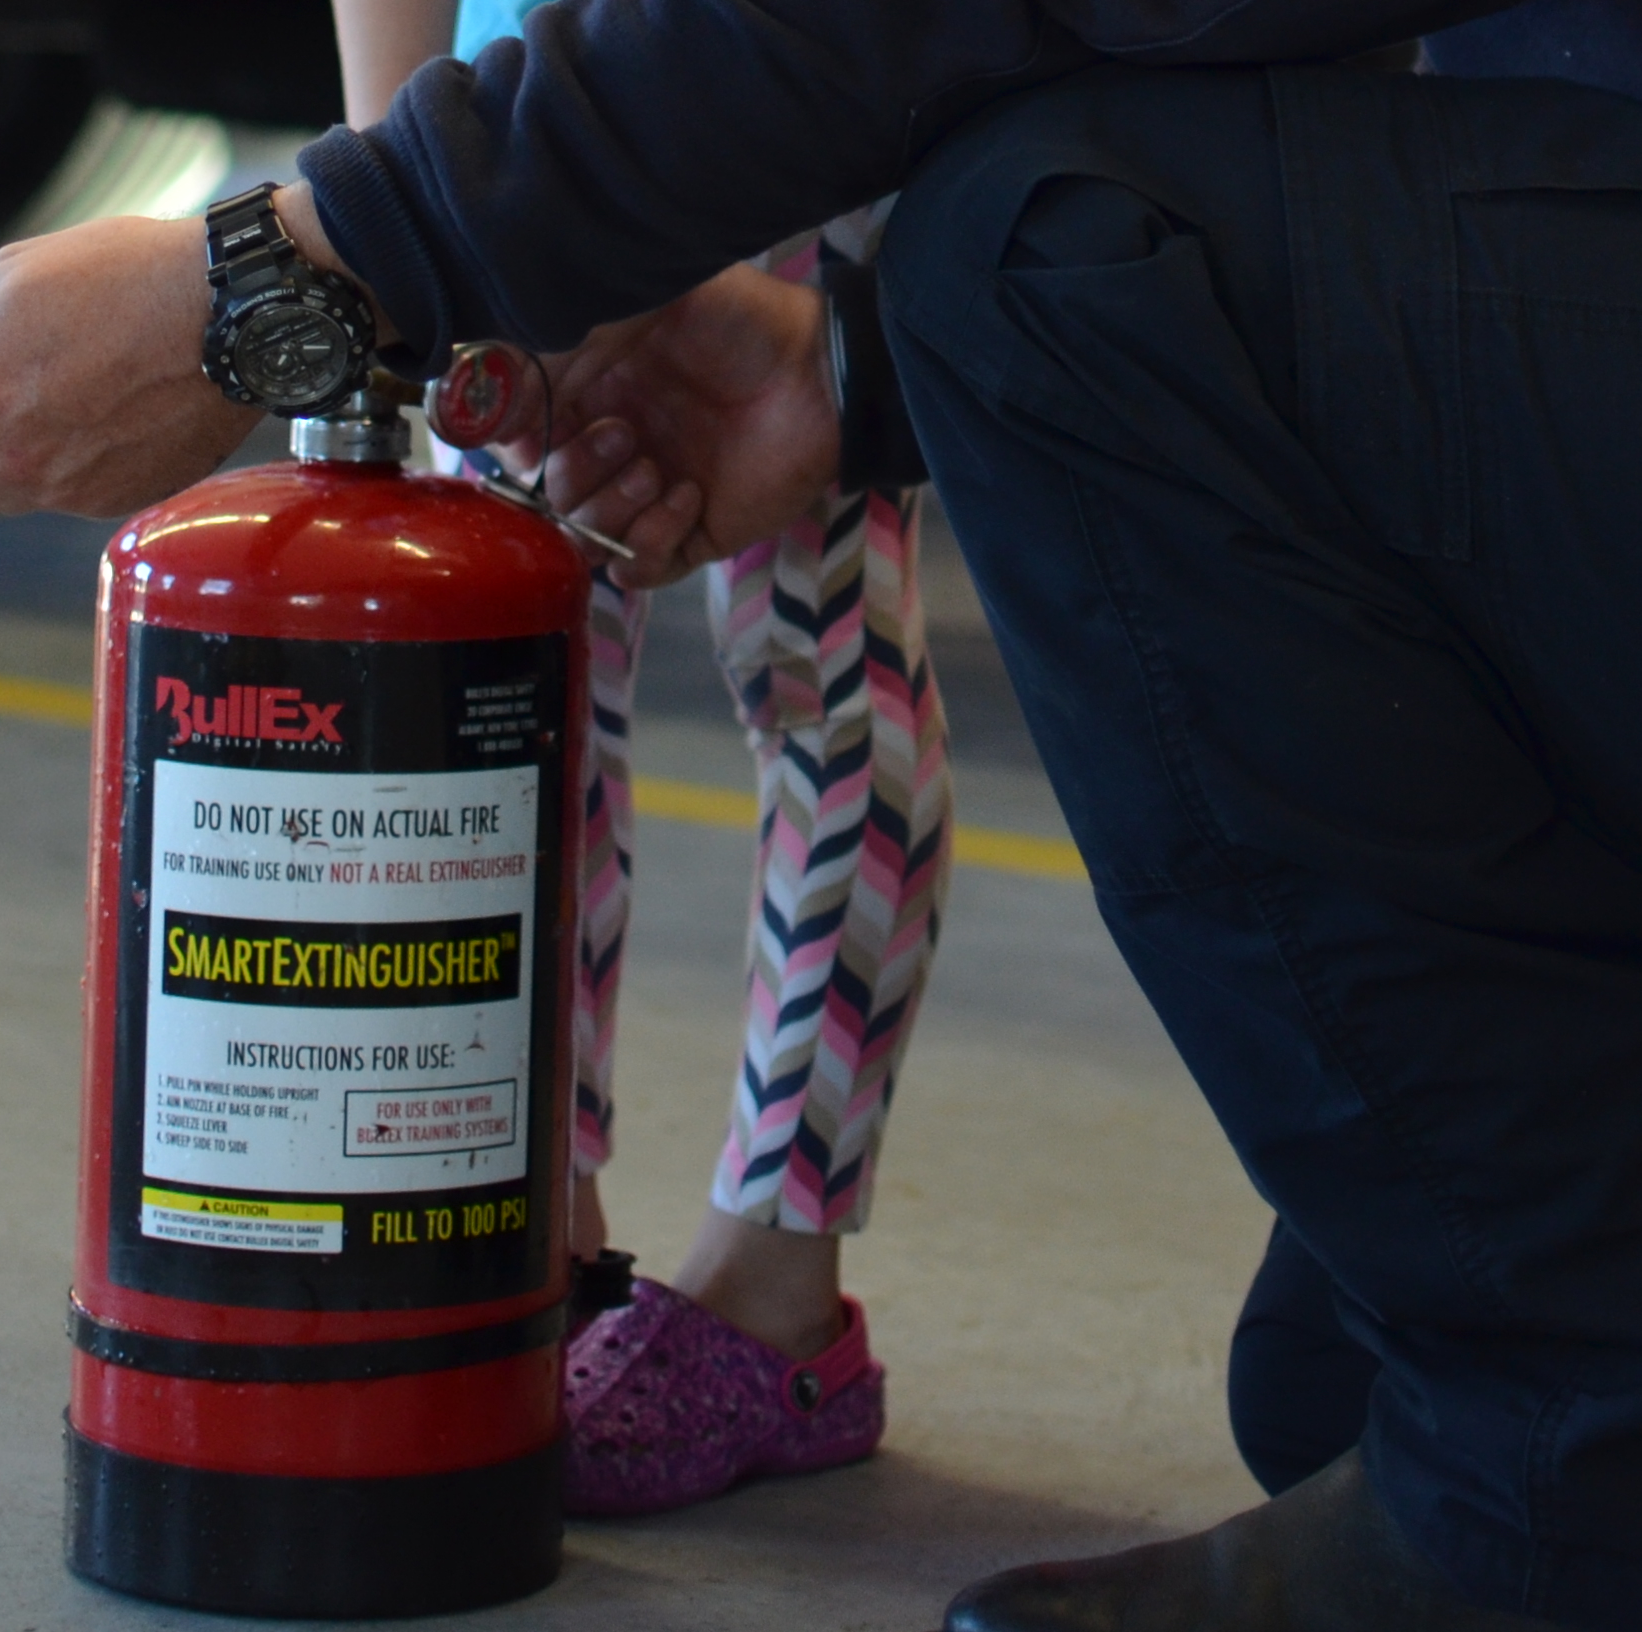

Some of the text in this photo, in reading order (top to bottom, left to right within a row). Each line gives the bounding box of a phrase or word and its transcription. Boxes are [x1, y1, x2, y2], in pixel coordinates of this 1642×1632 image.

[155, 675, 345, 747] BullEx
[192, 732, 261, 751] Digital
[194, 801, 500, 838] DO NOT USE ON ACTUAL FIRE
[163, 852, 526, 884] FOR TRAINING USE ONLY NOT A REAL EXTINGUISHER
[227, 1041, 455, 1071] INSTRUCTIONS FOR USE:
[204, 1081, 230, 1096] WHILE
[233, 1084, 275, 1099] HOLDING
[278, 1087, 319, 1101] UPRIGHT
[183, 1097, 213, 1113] NOZZLE
[216, 1101, 226, 1114] AT
[229, 1102, 251, 1117] BASE
[254, 1104, 266, 1117] OF
[268, 1105, 289, 1119] FIRE
[377, 1095, 492, 1119] FOR USE ONLY WITH
[166, 1113, 201, 1130] SQUEEZE
[202, 1118, 227, 1133] LEVER
[406, 1123, 461, 1143] TRAINING
[465, 1117, 509, 1138] SYSTEMS
[165, 1132, 190, 1148] SWEEP
[193, 1135, 211, 1150] SIDE
[214, 1139, 226, 1152] TO
[228, 1140, 248, 1154] SIDE
[213, 1202, 269, 1216] CAUTION
[371, 1197, 526, 1245] FILL TO 100 PSI
